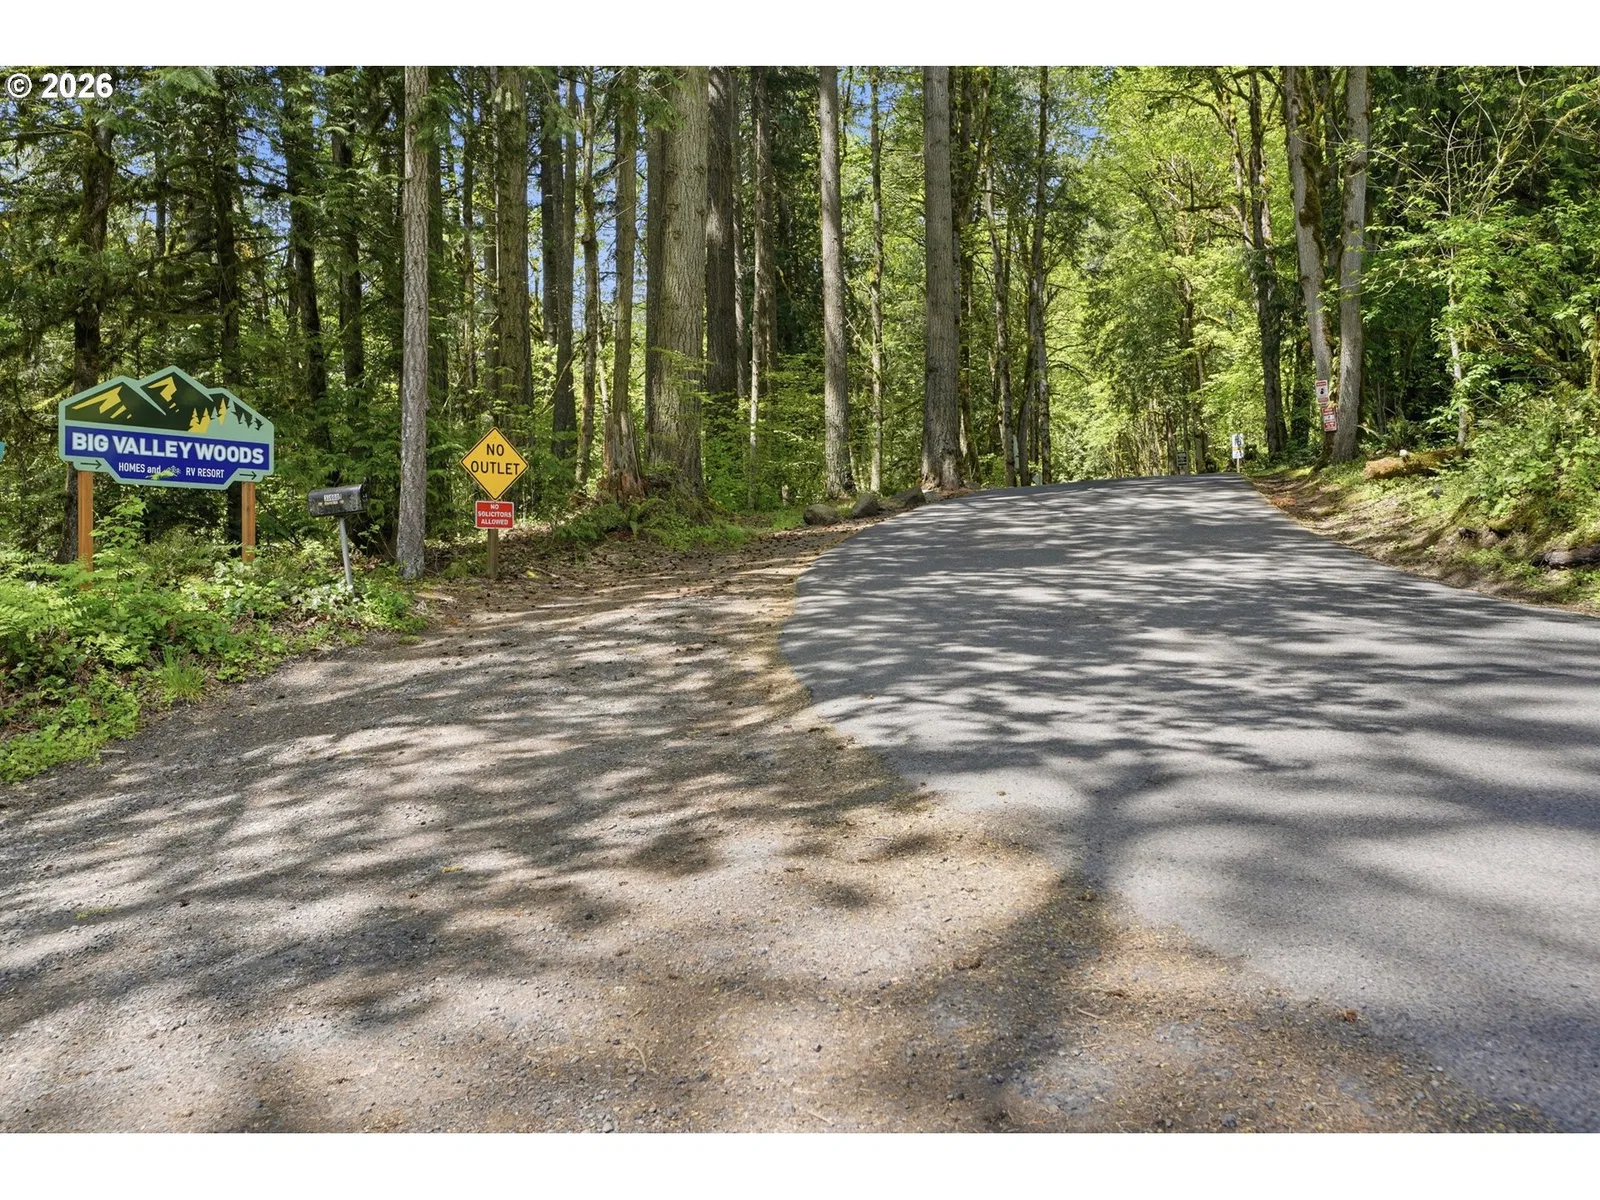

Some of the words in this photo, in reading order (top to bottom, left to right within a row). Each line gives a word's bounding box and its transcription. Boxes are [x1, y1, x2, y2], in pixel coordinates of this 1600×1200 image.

[72, 432, 109, 452] BIG
[112, 435, 193, 459] VALLEY
[194, 442, 264, 465] WOODS
[486, 443, 504, 457] NO
[118, 462, 146, 473] HOMES
[147, 465, 161, 474] and
[185, 466, 196, 477] RV
[197, 468, 225, 478] RESORT
[470, 460, 520, 475] OUTLET
